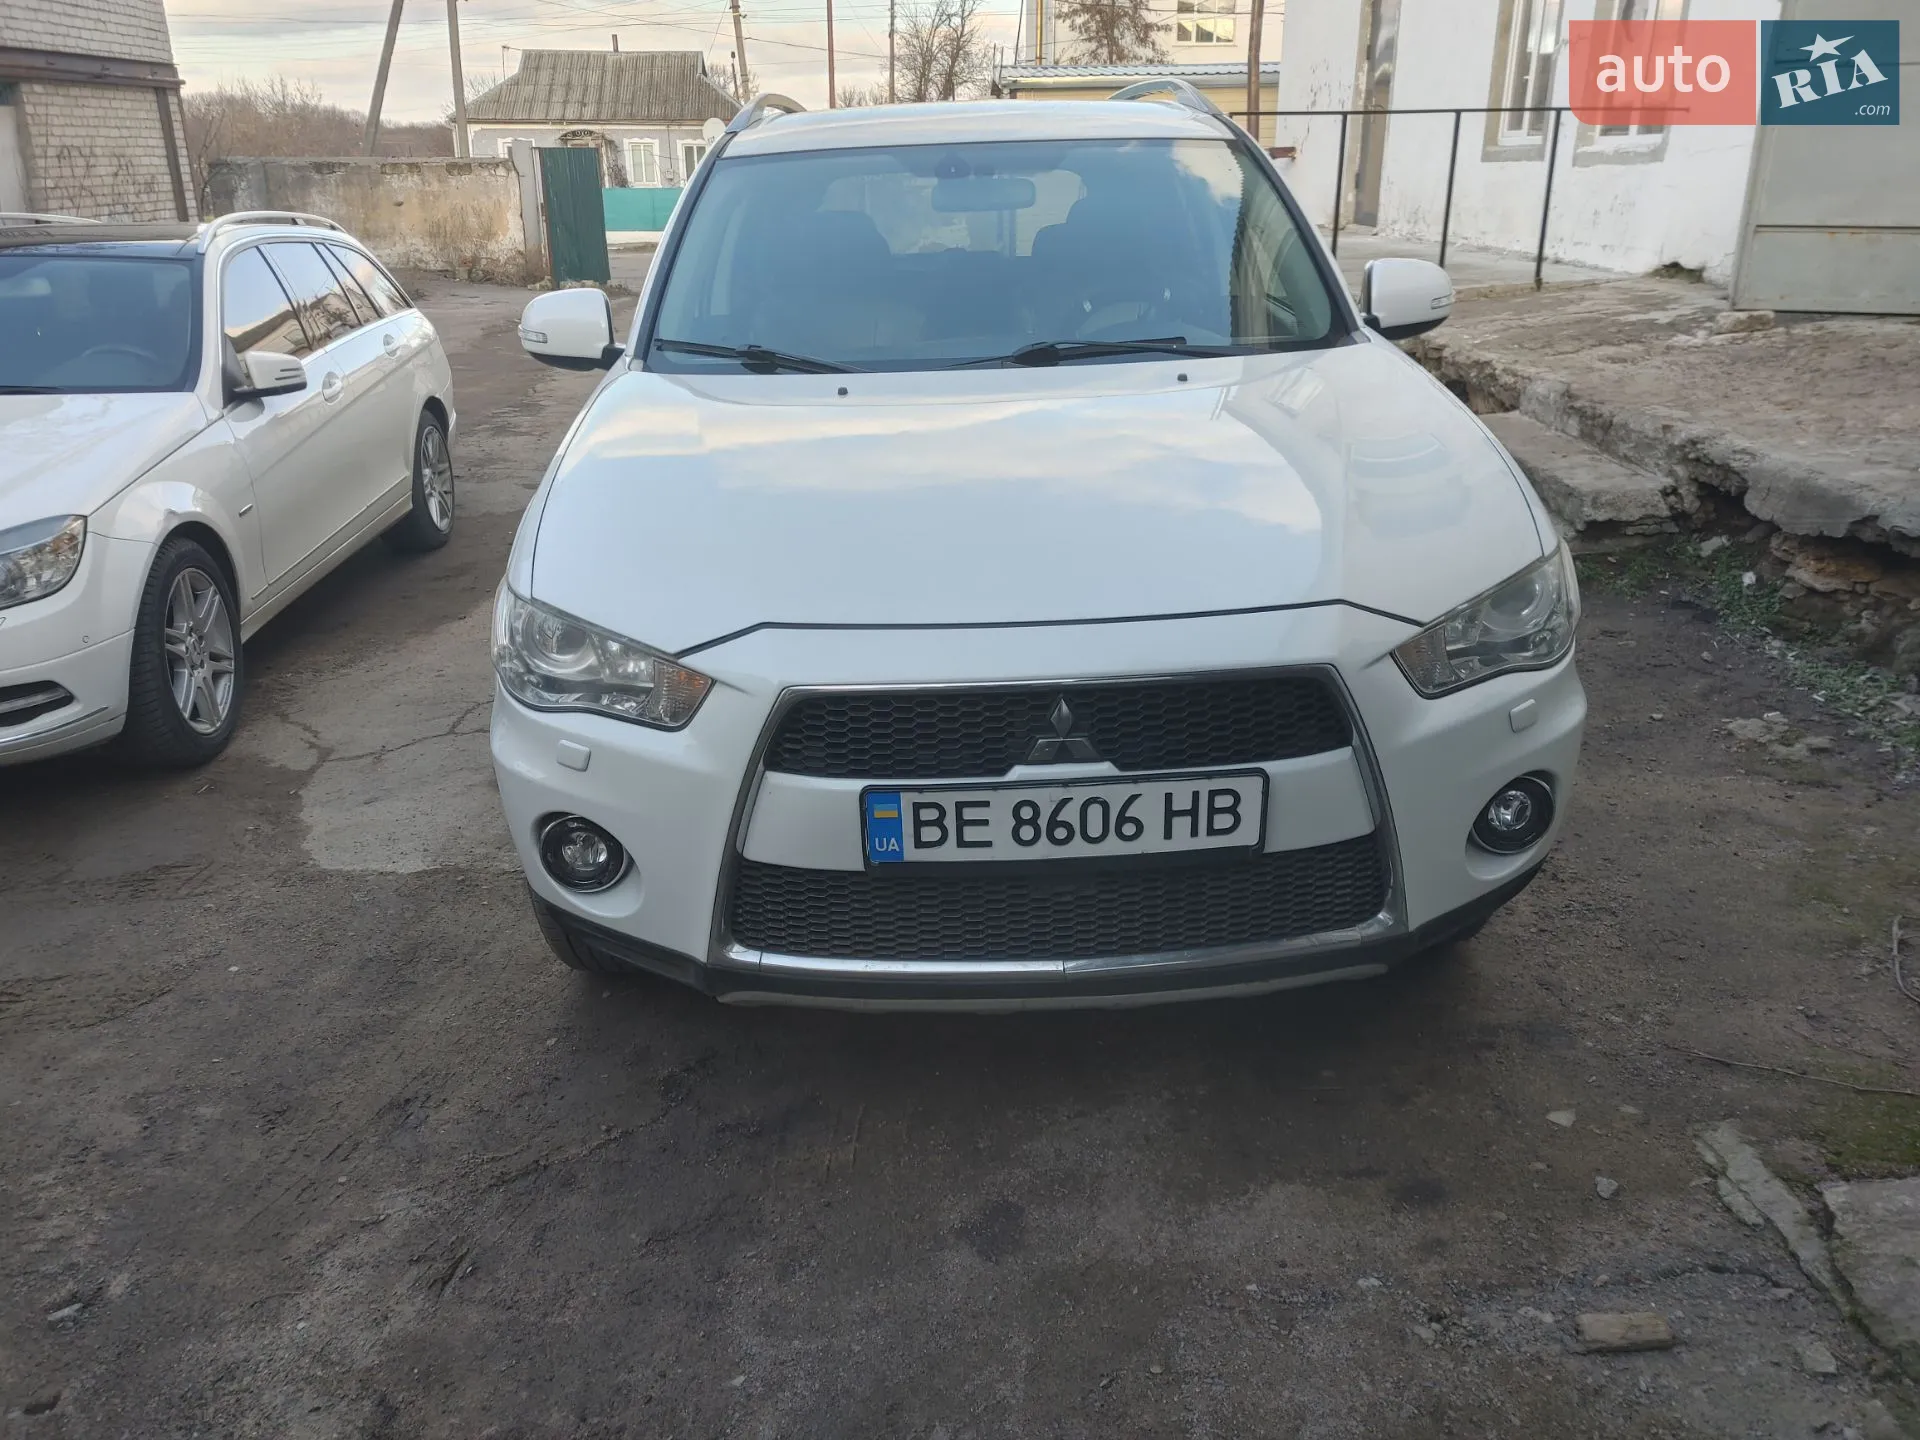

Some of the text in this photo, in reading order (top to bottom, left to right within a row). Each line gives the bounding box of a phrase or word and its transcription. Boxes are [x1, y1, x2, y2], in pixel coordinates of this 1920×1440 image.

[912, 787, 1242, 849] BE 8606 HB
[875, 838, 900, 852] UA
